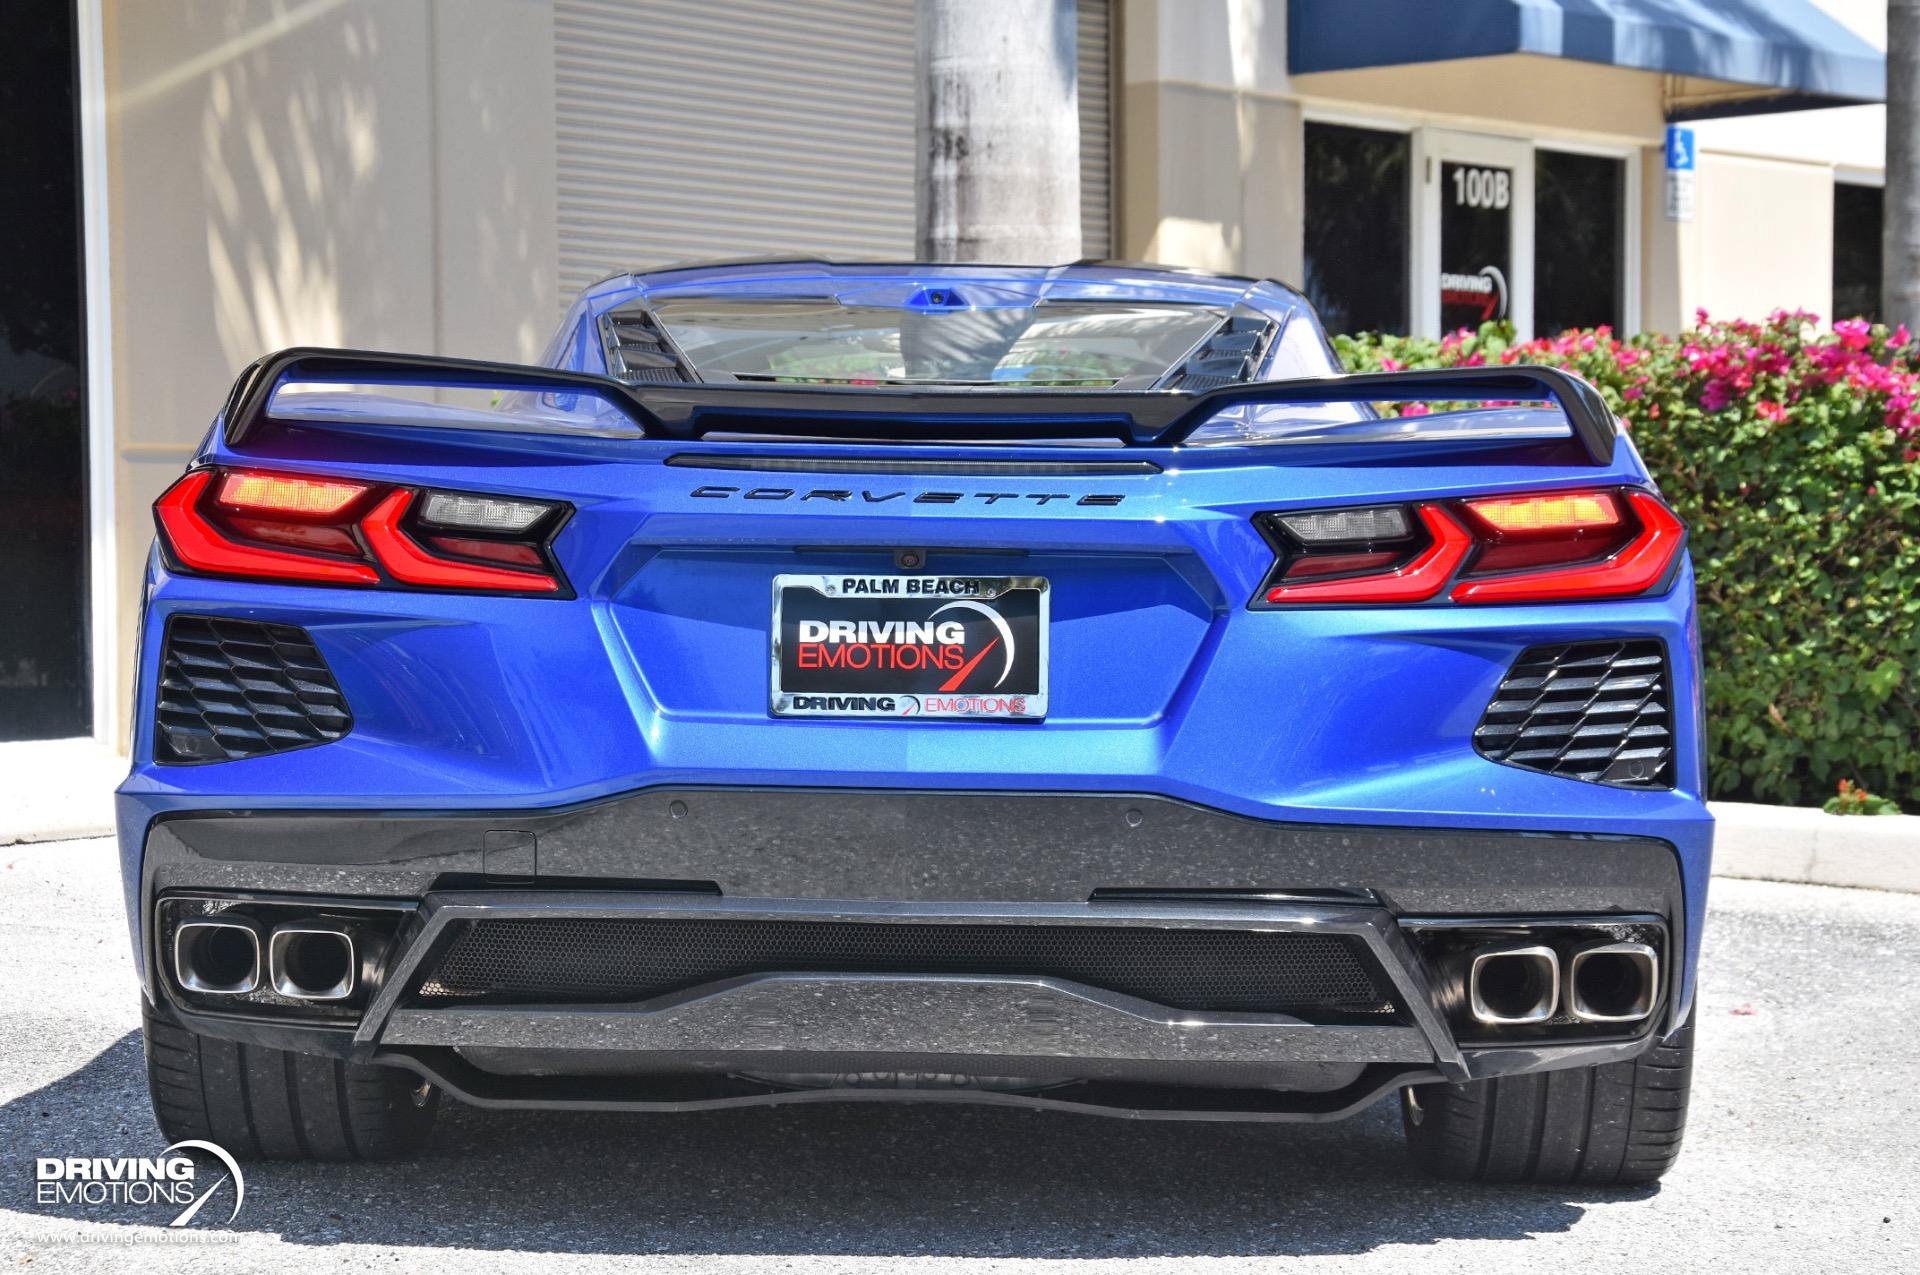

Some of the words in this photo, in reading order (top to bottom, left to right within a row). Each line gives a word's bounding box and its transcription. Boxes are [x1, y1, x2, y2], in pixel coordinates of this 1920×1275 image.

[1453, 167, 1510, 210] 100B
[1441, 272, 1493, 294] DRIVING
[690, 485, 1126, 506] CORVETTE
[842, 578, 900, 595] PALM
[906, 578, 980, 595] BEACH
[799, 619, 966, 645] DRIVING
[798, 643, 966, 671] EMOTIONS
[793, 696, 896, 711] DRIVING
[924, 697, 1026, 713] EMOTIONS
